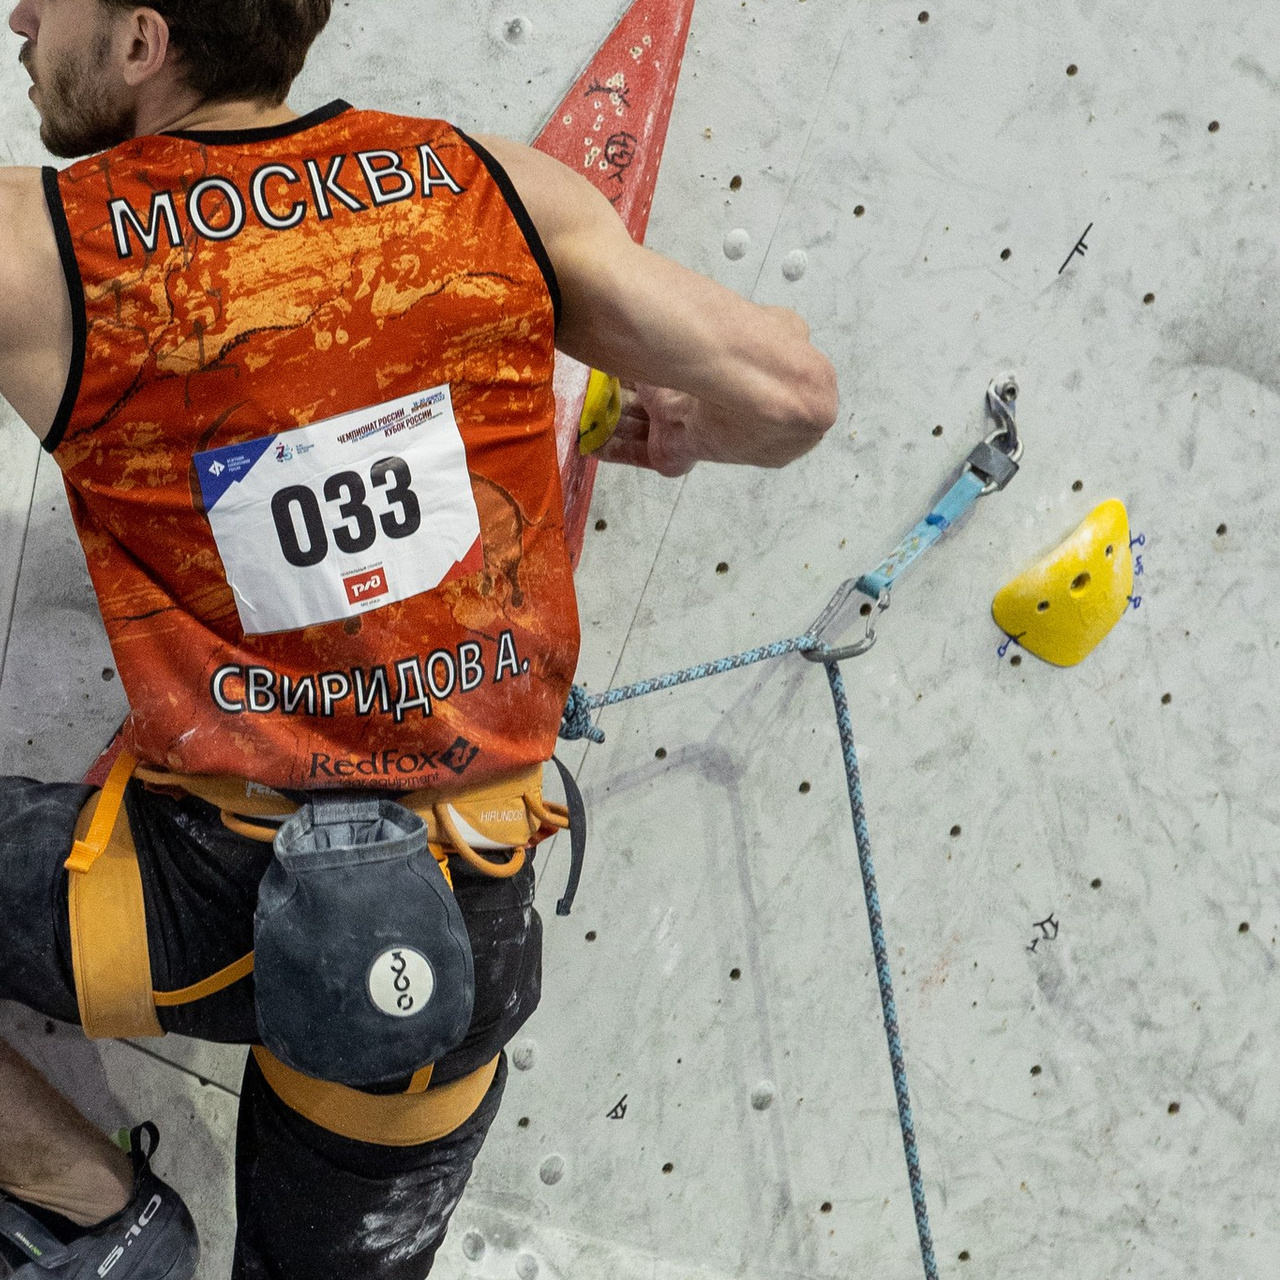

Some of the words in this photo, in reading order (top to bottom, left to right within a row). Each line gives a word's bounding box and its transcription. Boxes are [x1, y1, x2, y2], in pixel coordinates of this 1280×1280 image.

[107, 142, 466, 260] МОСКВА
[336, 420, 379, 445] ЧЕМПИОНАТ
[378, 407, 406, 428] РОССИИ
[383, 422, 407, 438] КУБОК
[405, 408, 433, 428] РОССИИ
[270, 456, 421, 568] 033
[210, 640, 485, 723] СВИРИДОВ
[493, 629, 531, 683] А.
[480, 809, 523, 823] HIRUNDOS
[96, 1193, 163, 1279] 5.10
